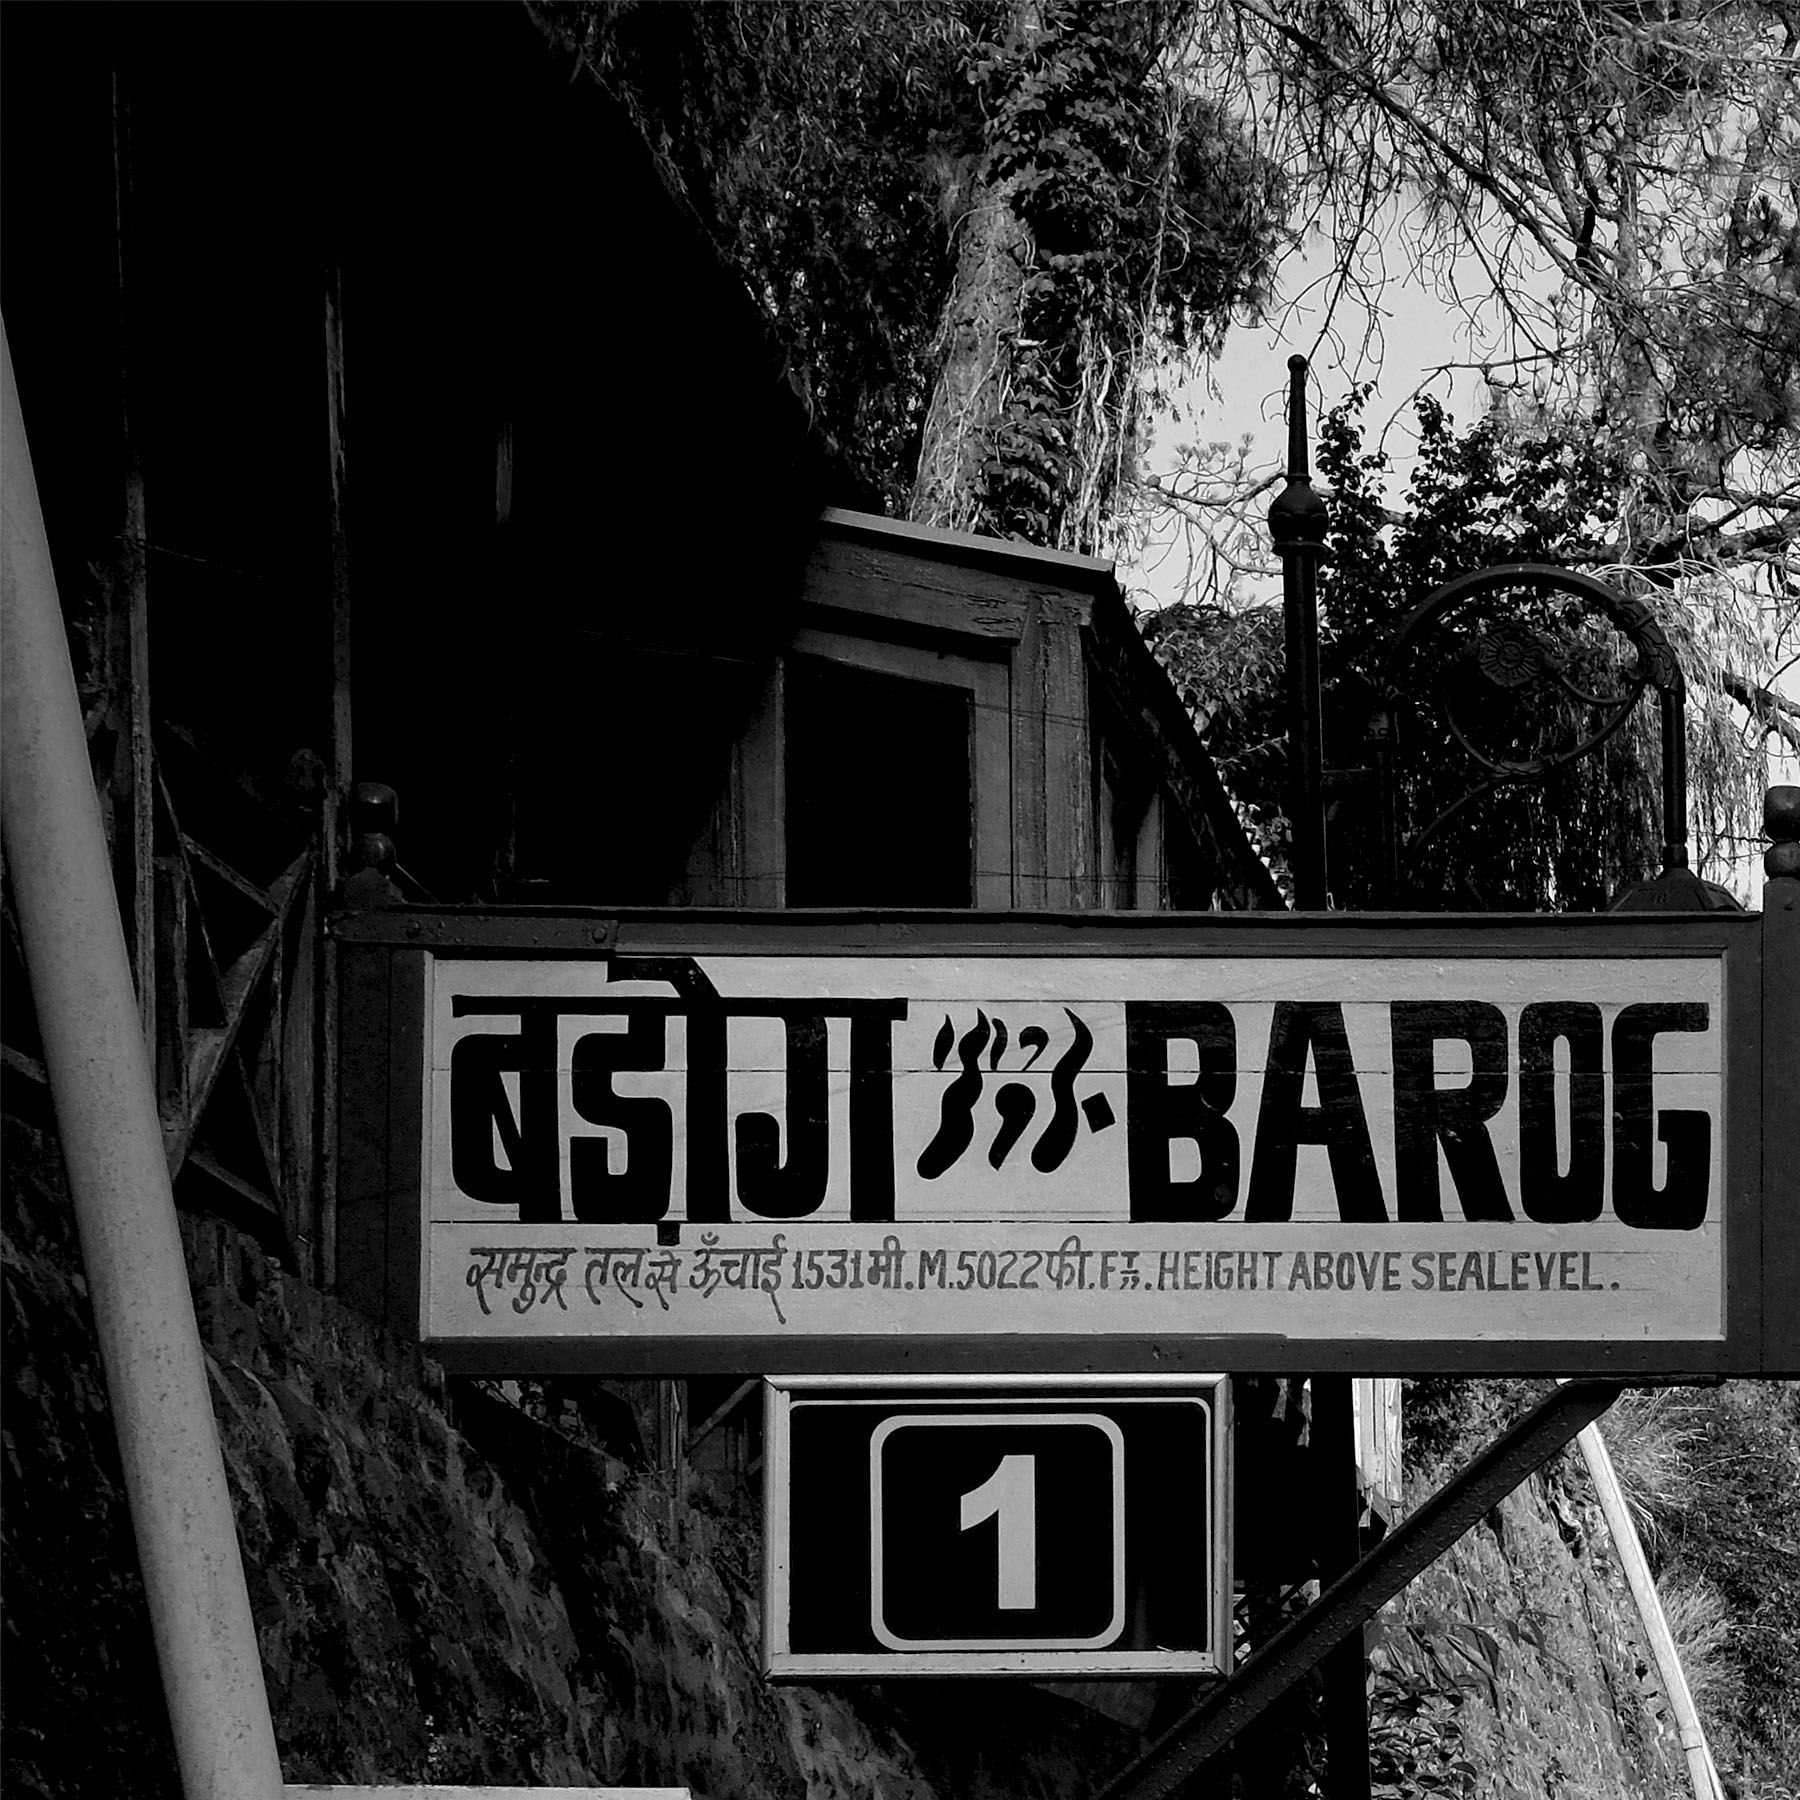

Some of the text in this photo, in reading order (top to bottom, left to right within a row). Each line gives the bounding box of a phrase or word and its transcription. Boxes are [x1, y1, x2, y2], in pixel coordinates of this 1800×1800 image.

[1128, 1000, 1711, 1231] BAROG
[1288, 1251, 1402, 1292] ABOVE
[958, 1454, 1037, 1611] 1
